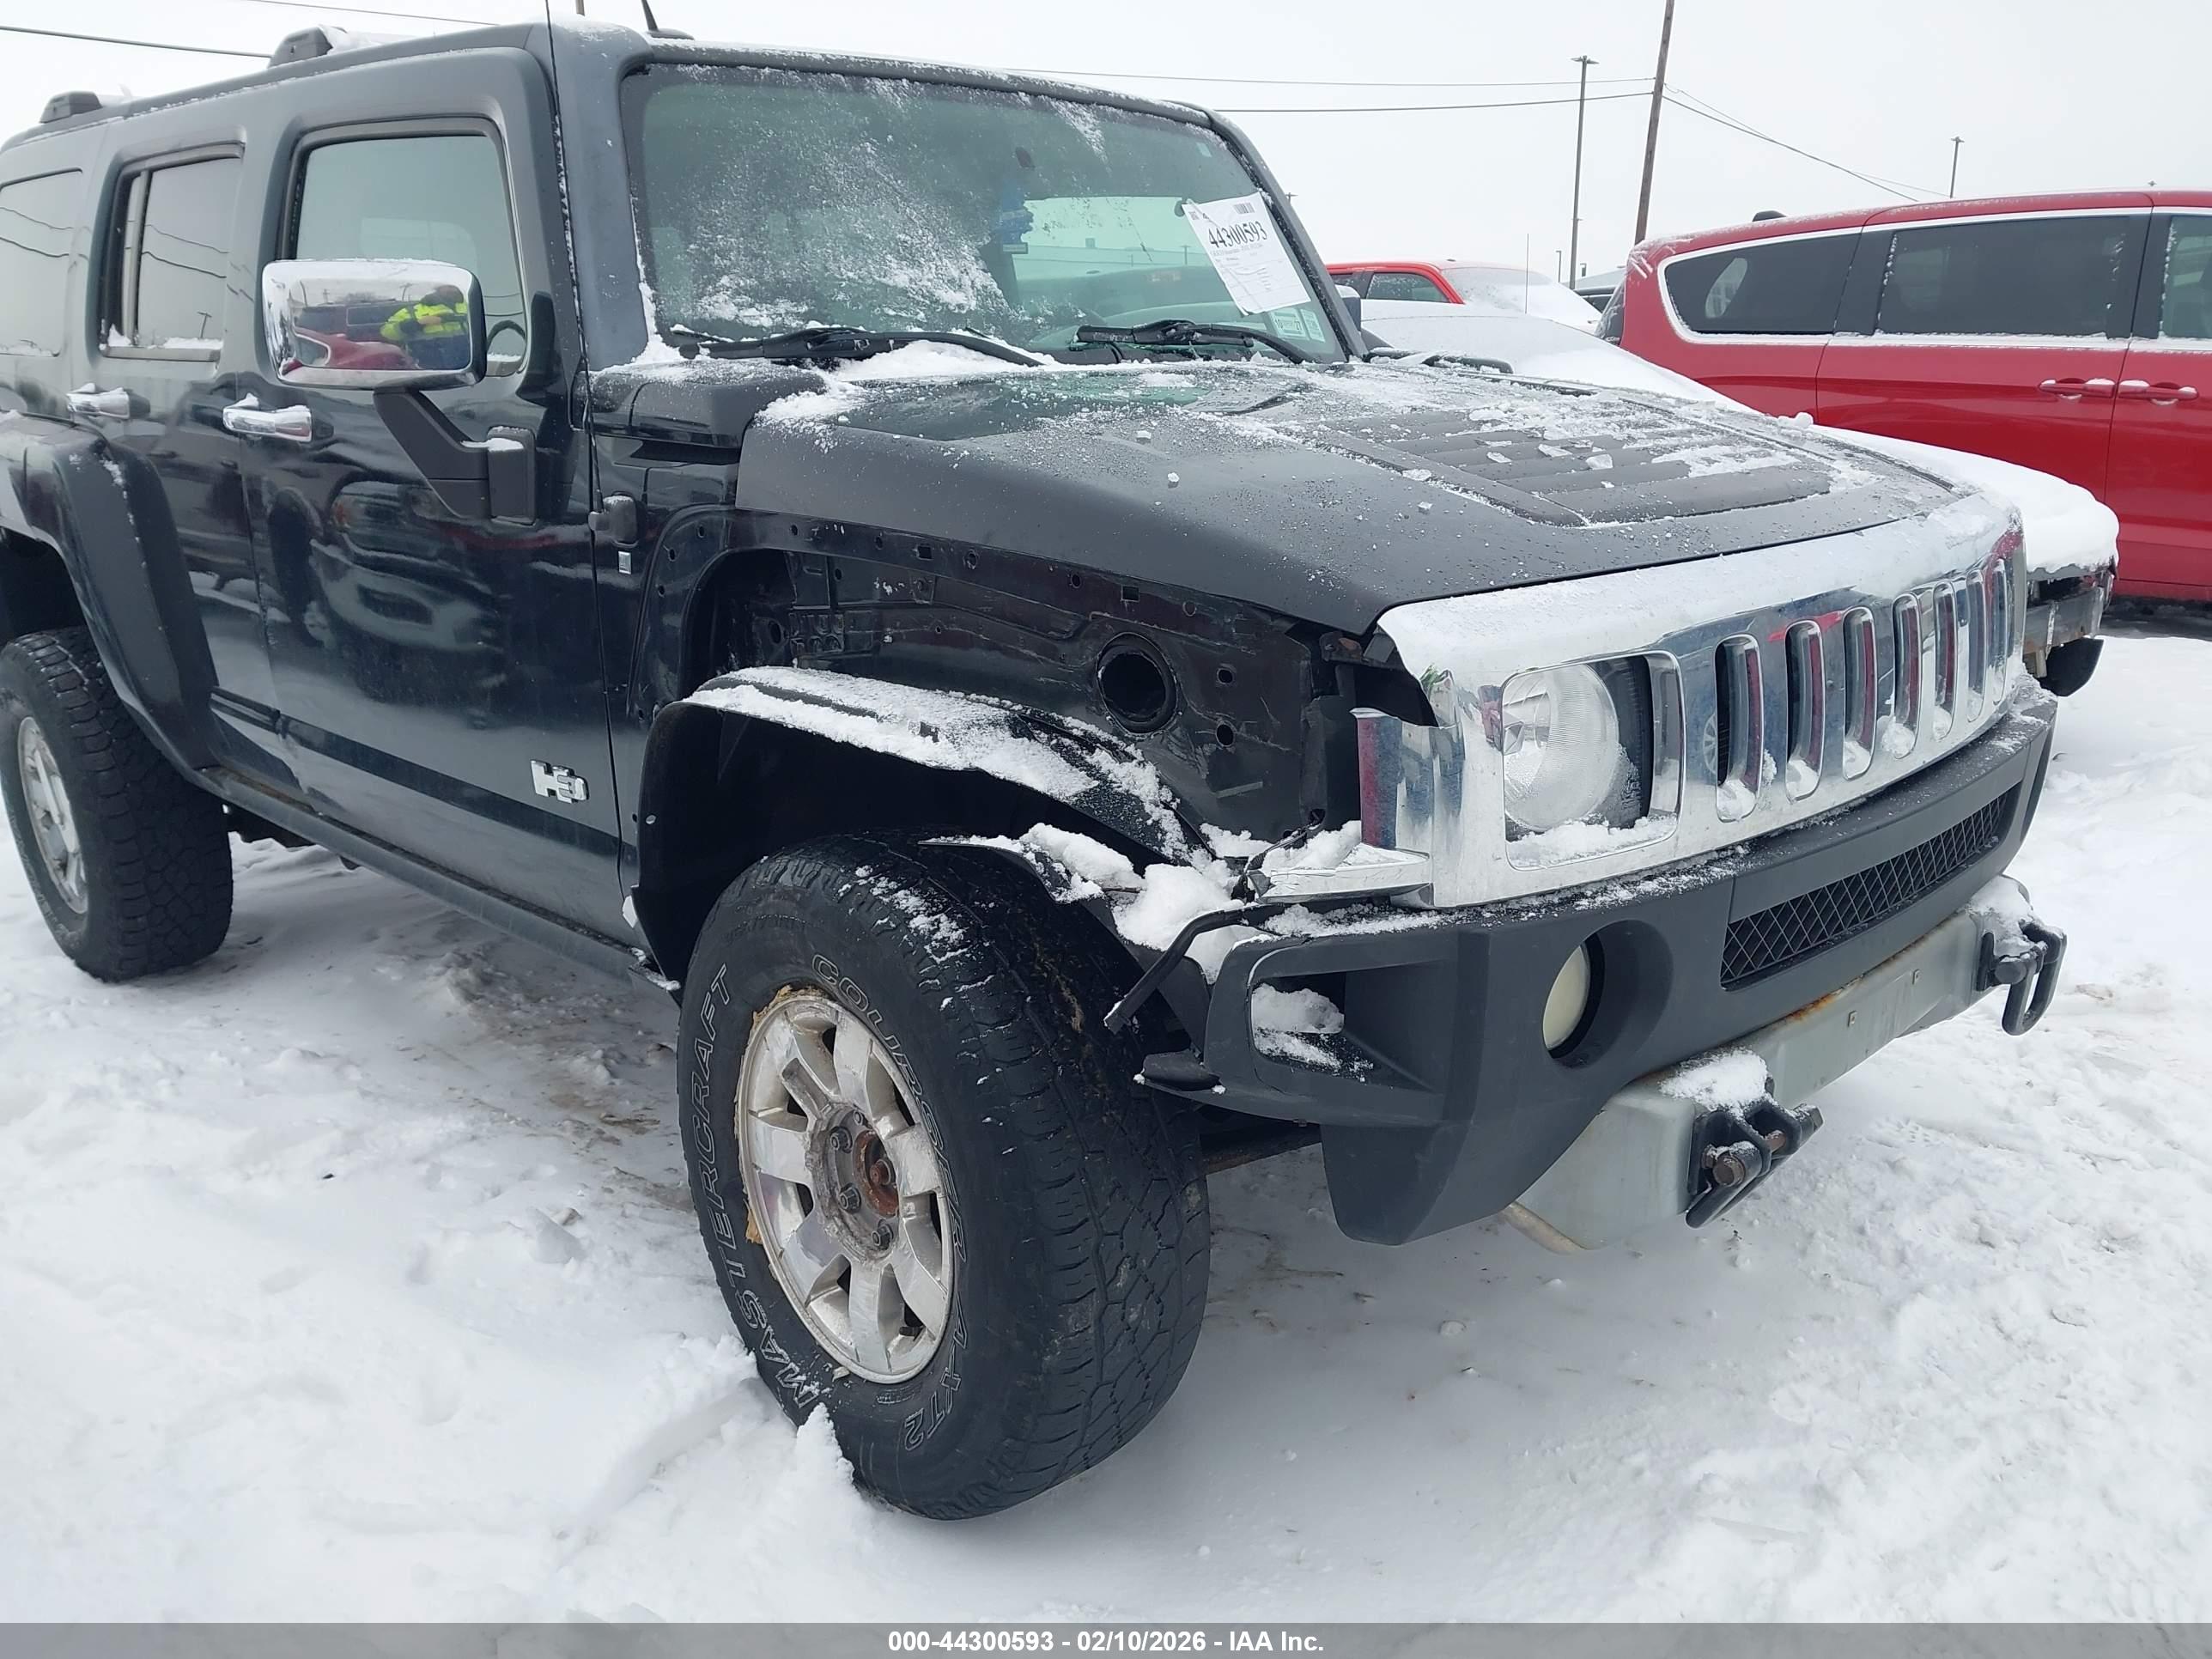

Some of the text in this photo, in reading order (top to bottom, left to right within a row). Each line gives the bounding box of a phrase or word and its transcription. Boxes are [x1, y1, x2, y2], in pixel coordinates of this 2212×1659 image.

[1208, 221, 1267, 248] 44300593
[530, 759, 589, 804] H3
[690, 963, 818, 1410] MASTERCRAFT
[811, 953, 968, 1263] COURSER
